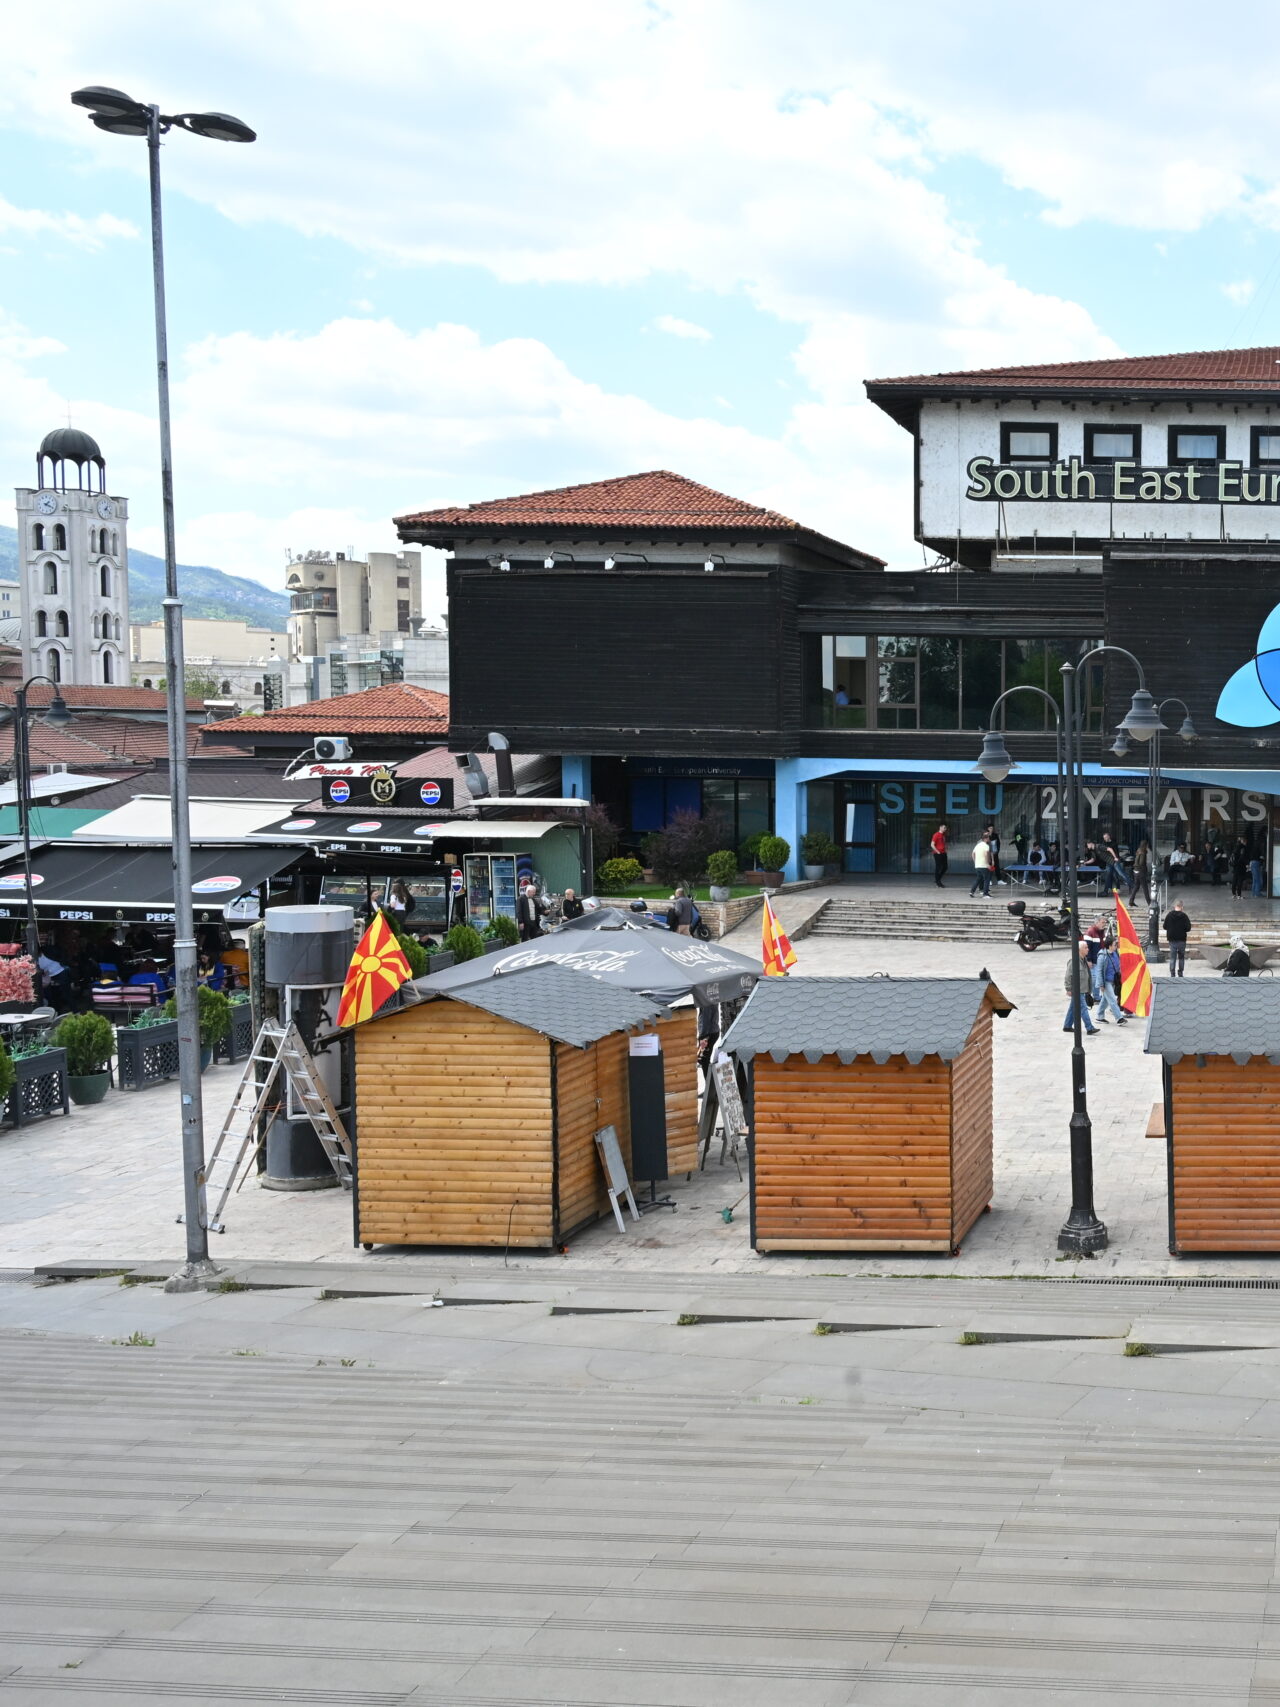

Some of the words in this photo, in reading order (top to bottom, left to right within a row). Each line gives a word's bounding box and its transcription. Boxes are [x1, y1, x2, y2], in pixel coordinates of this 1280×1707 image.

[967, 458, 1096, 500] South
[1113, 461, 1201, 501] East
[880, 782, 1004, 815] SEEU
[1082, 786, 1267, 821] YEARS
[380, 845, 402, 853] PEPSI
[59, 910, 94, 920] PEPSI
[146, 912, 177, 922] PEPS
